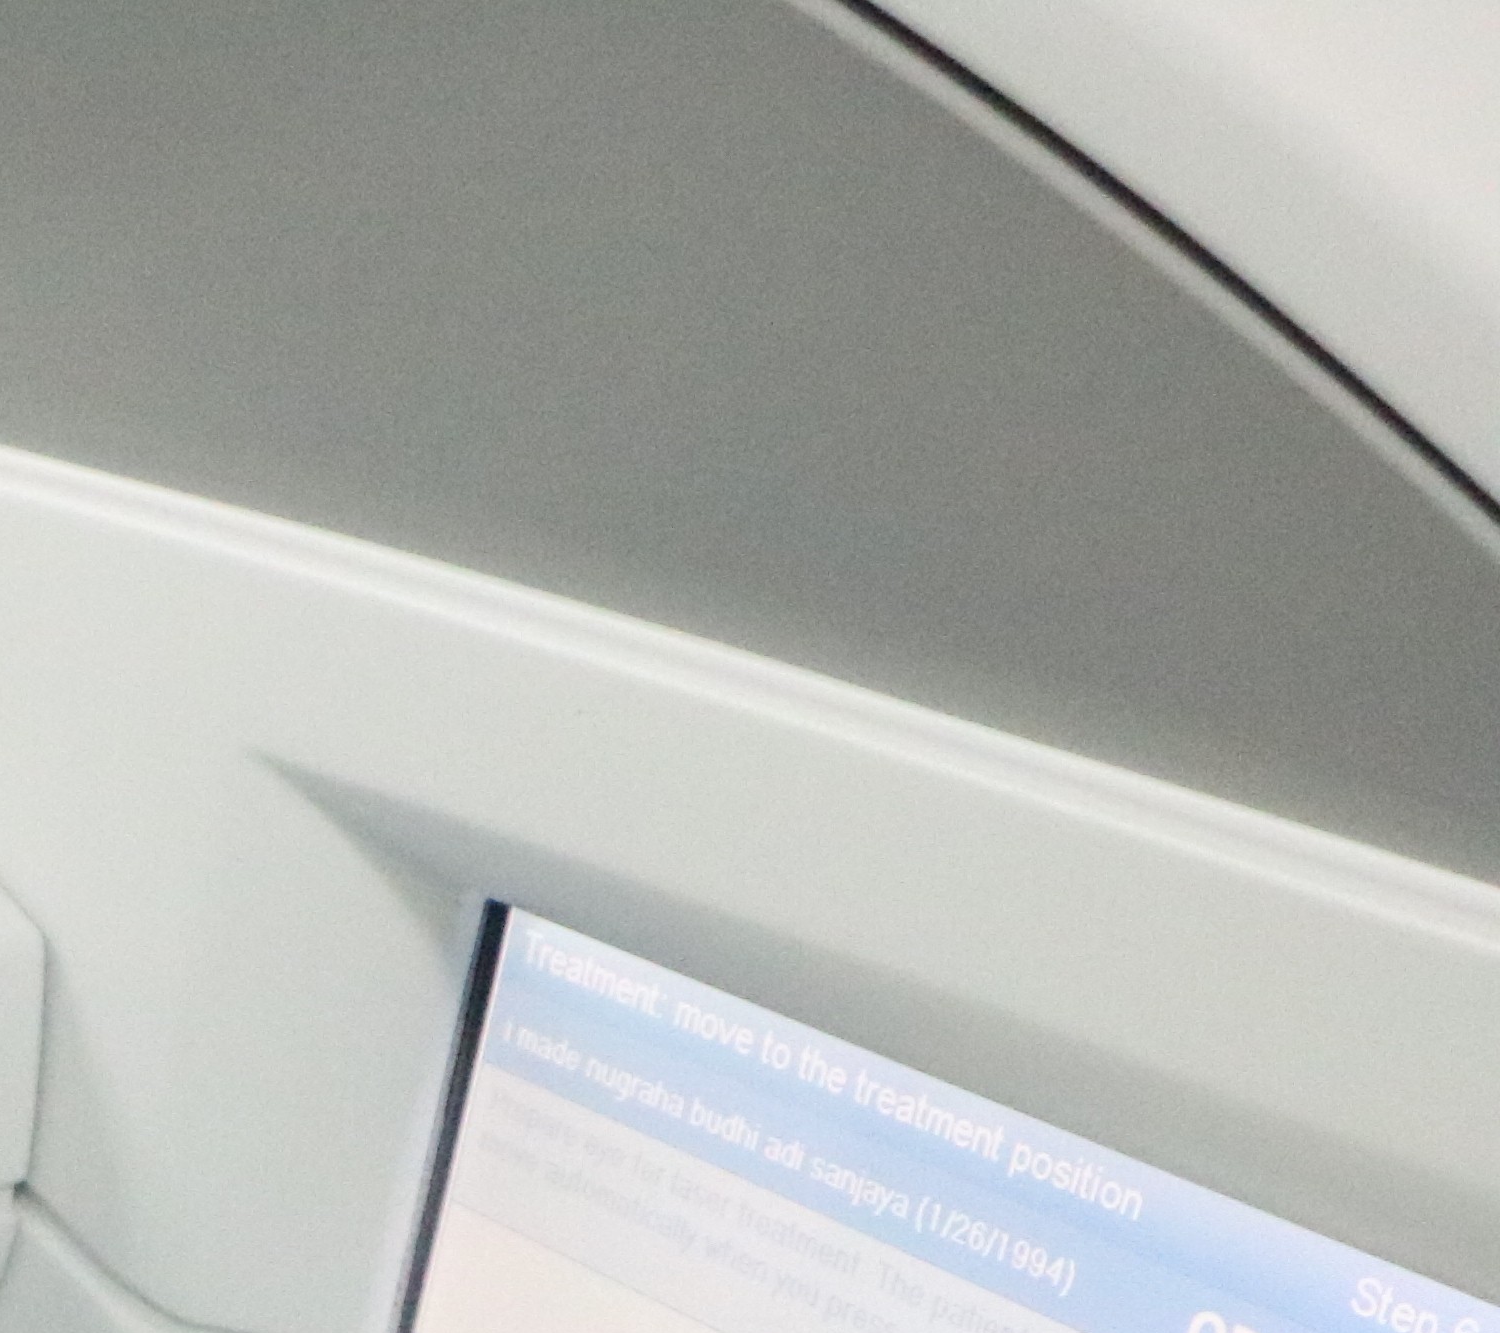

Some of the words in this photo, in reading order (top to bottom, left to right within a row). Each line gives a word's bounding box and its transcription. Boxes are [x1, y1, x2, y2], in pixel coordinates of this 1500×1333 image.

[516, 1027, 580, 1071] made
[585, 1058, 685, 1120] nugraha
[689, 1097, 762, 1151] budhi
[764, 1136, 806, 1171] adi
[810, 1156, 910, 1220] sanjaya
[672, 1002, 754, 1055] move
[760, 1029, 791, 1070] to
[798, 1045, 847, 1094] the
[852, 1068, 1004, 1162] treatment
[1008, 1142, 1144, 1221] position
[878, 1260, 924, 1309] The
